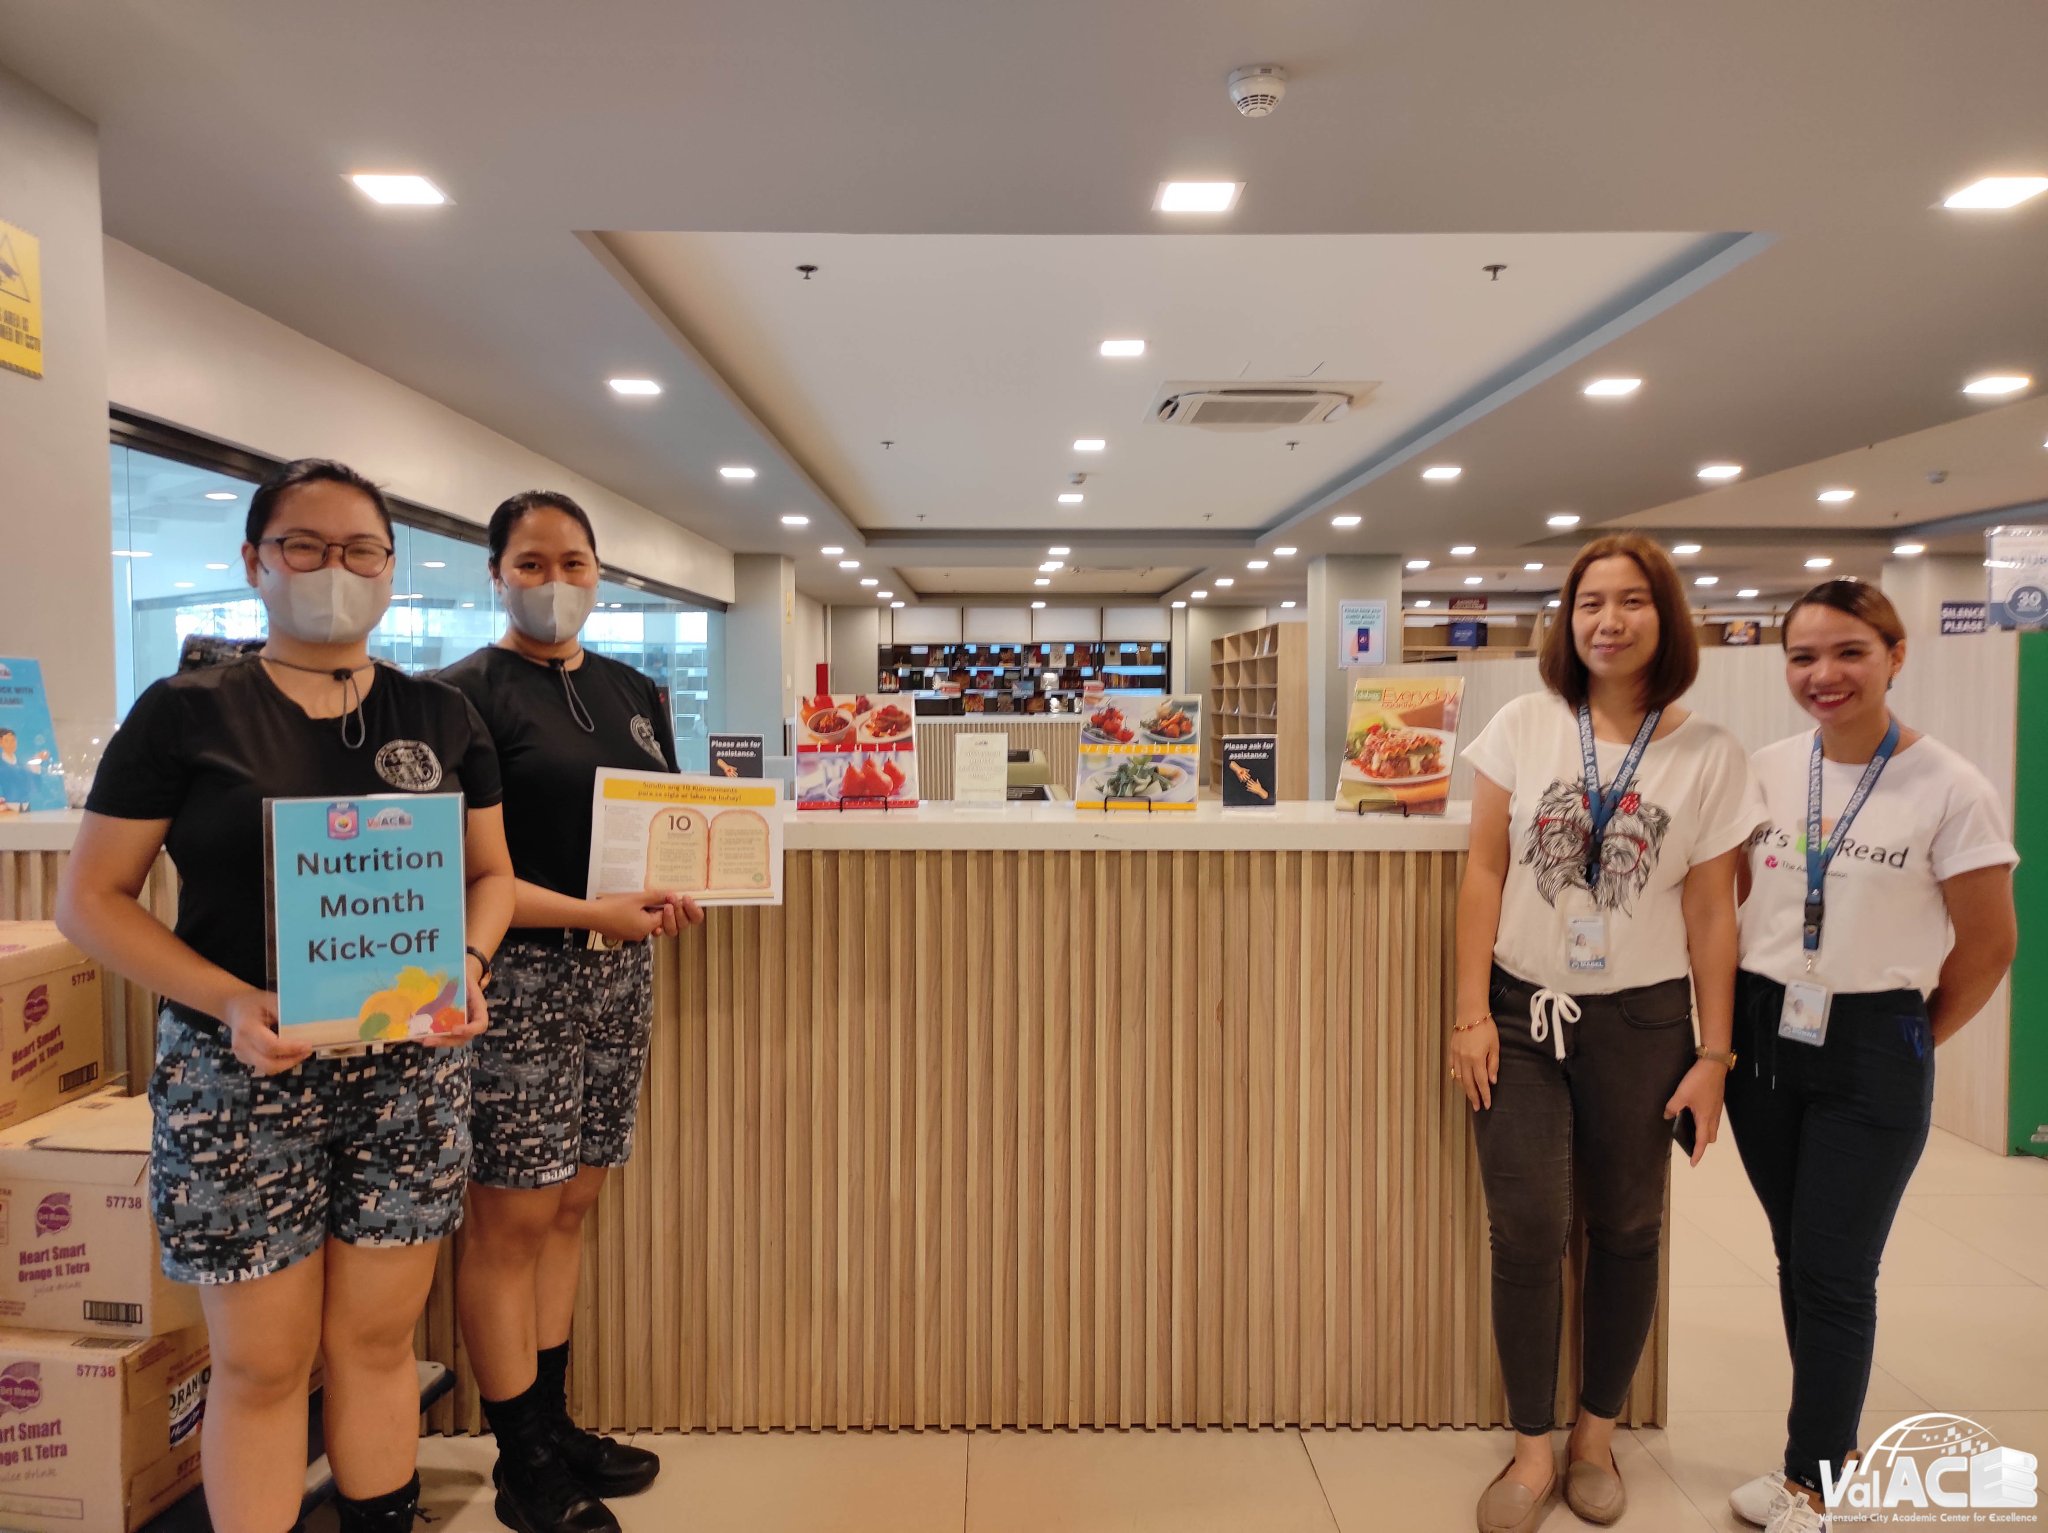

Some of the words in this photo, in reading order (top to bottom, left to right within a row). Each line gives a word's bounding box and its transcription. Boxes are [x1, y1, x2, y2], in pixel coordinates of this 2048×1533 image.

[1942, 607, 1986, 619] SILENCE
[1382, 688, 1457, 705] Everyday
[711, 740, 734, 749] Please
[736, 740, 749, 749] ask
[750, 740, 762, 749] for
[716, 749, 757, 758] assistance.
[1086, 742, 1193, 754] vegetables
[1224, 741, 1247, 750] Please
[1248, 742, 1261, 750] ask
[1262, 741, 1274, 750] for
[1229, 751, 1269, 760] assistance.
[1585, 765, 1599, 792] CITY
[1808, 749, 1823, 821] VALENZUELA
[668, 815, 692, 831] 10
[1807, 823, 1821, 851] CITY
[297, 847, 444, 876] Nutrition
[1836, 838, 1910, 869] Read
[1782, 860, 1796, 870] The
[320, 888, 425, 918] Month
[308, 928, 440, 963] Kick-Off
[71, 969, 96, 986] 57738
[12, 1042, 36, 1065] Heart
[37, 1024, 61, 1050] Smart
[11, 1056, 38, 1082] Orange
[46, 1040, 64, 1060] Tetra
[541, 1164, 575, 1182] BJMP
[105, 1195, 142, 1210] 57738
[19, 1249, 50, 1265] Heart
[52, 1243, 86, 1260] Smart
[18, 1267, 53, 1283] Orange
[65, 1261, 90, 1275] Tetra
[199, 1259, 279, 1286] BJMP
[76, 1364, 116, 1378] 57738
[0, 1426, 15, 1444] art
[18, 1418, 62, 1441] Smart
[0, 1451, 18, 1466] nge
[23, 1446, 33, 1461] 1L
[35, 1443, 68, 1460] Tetra
